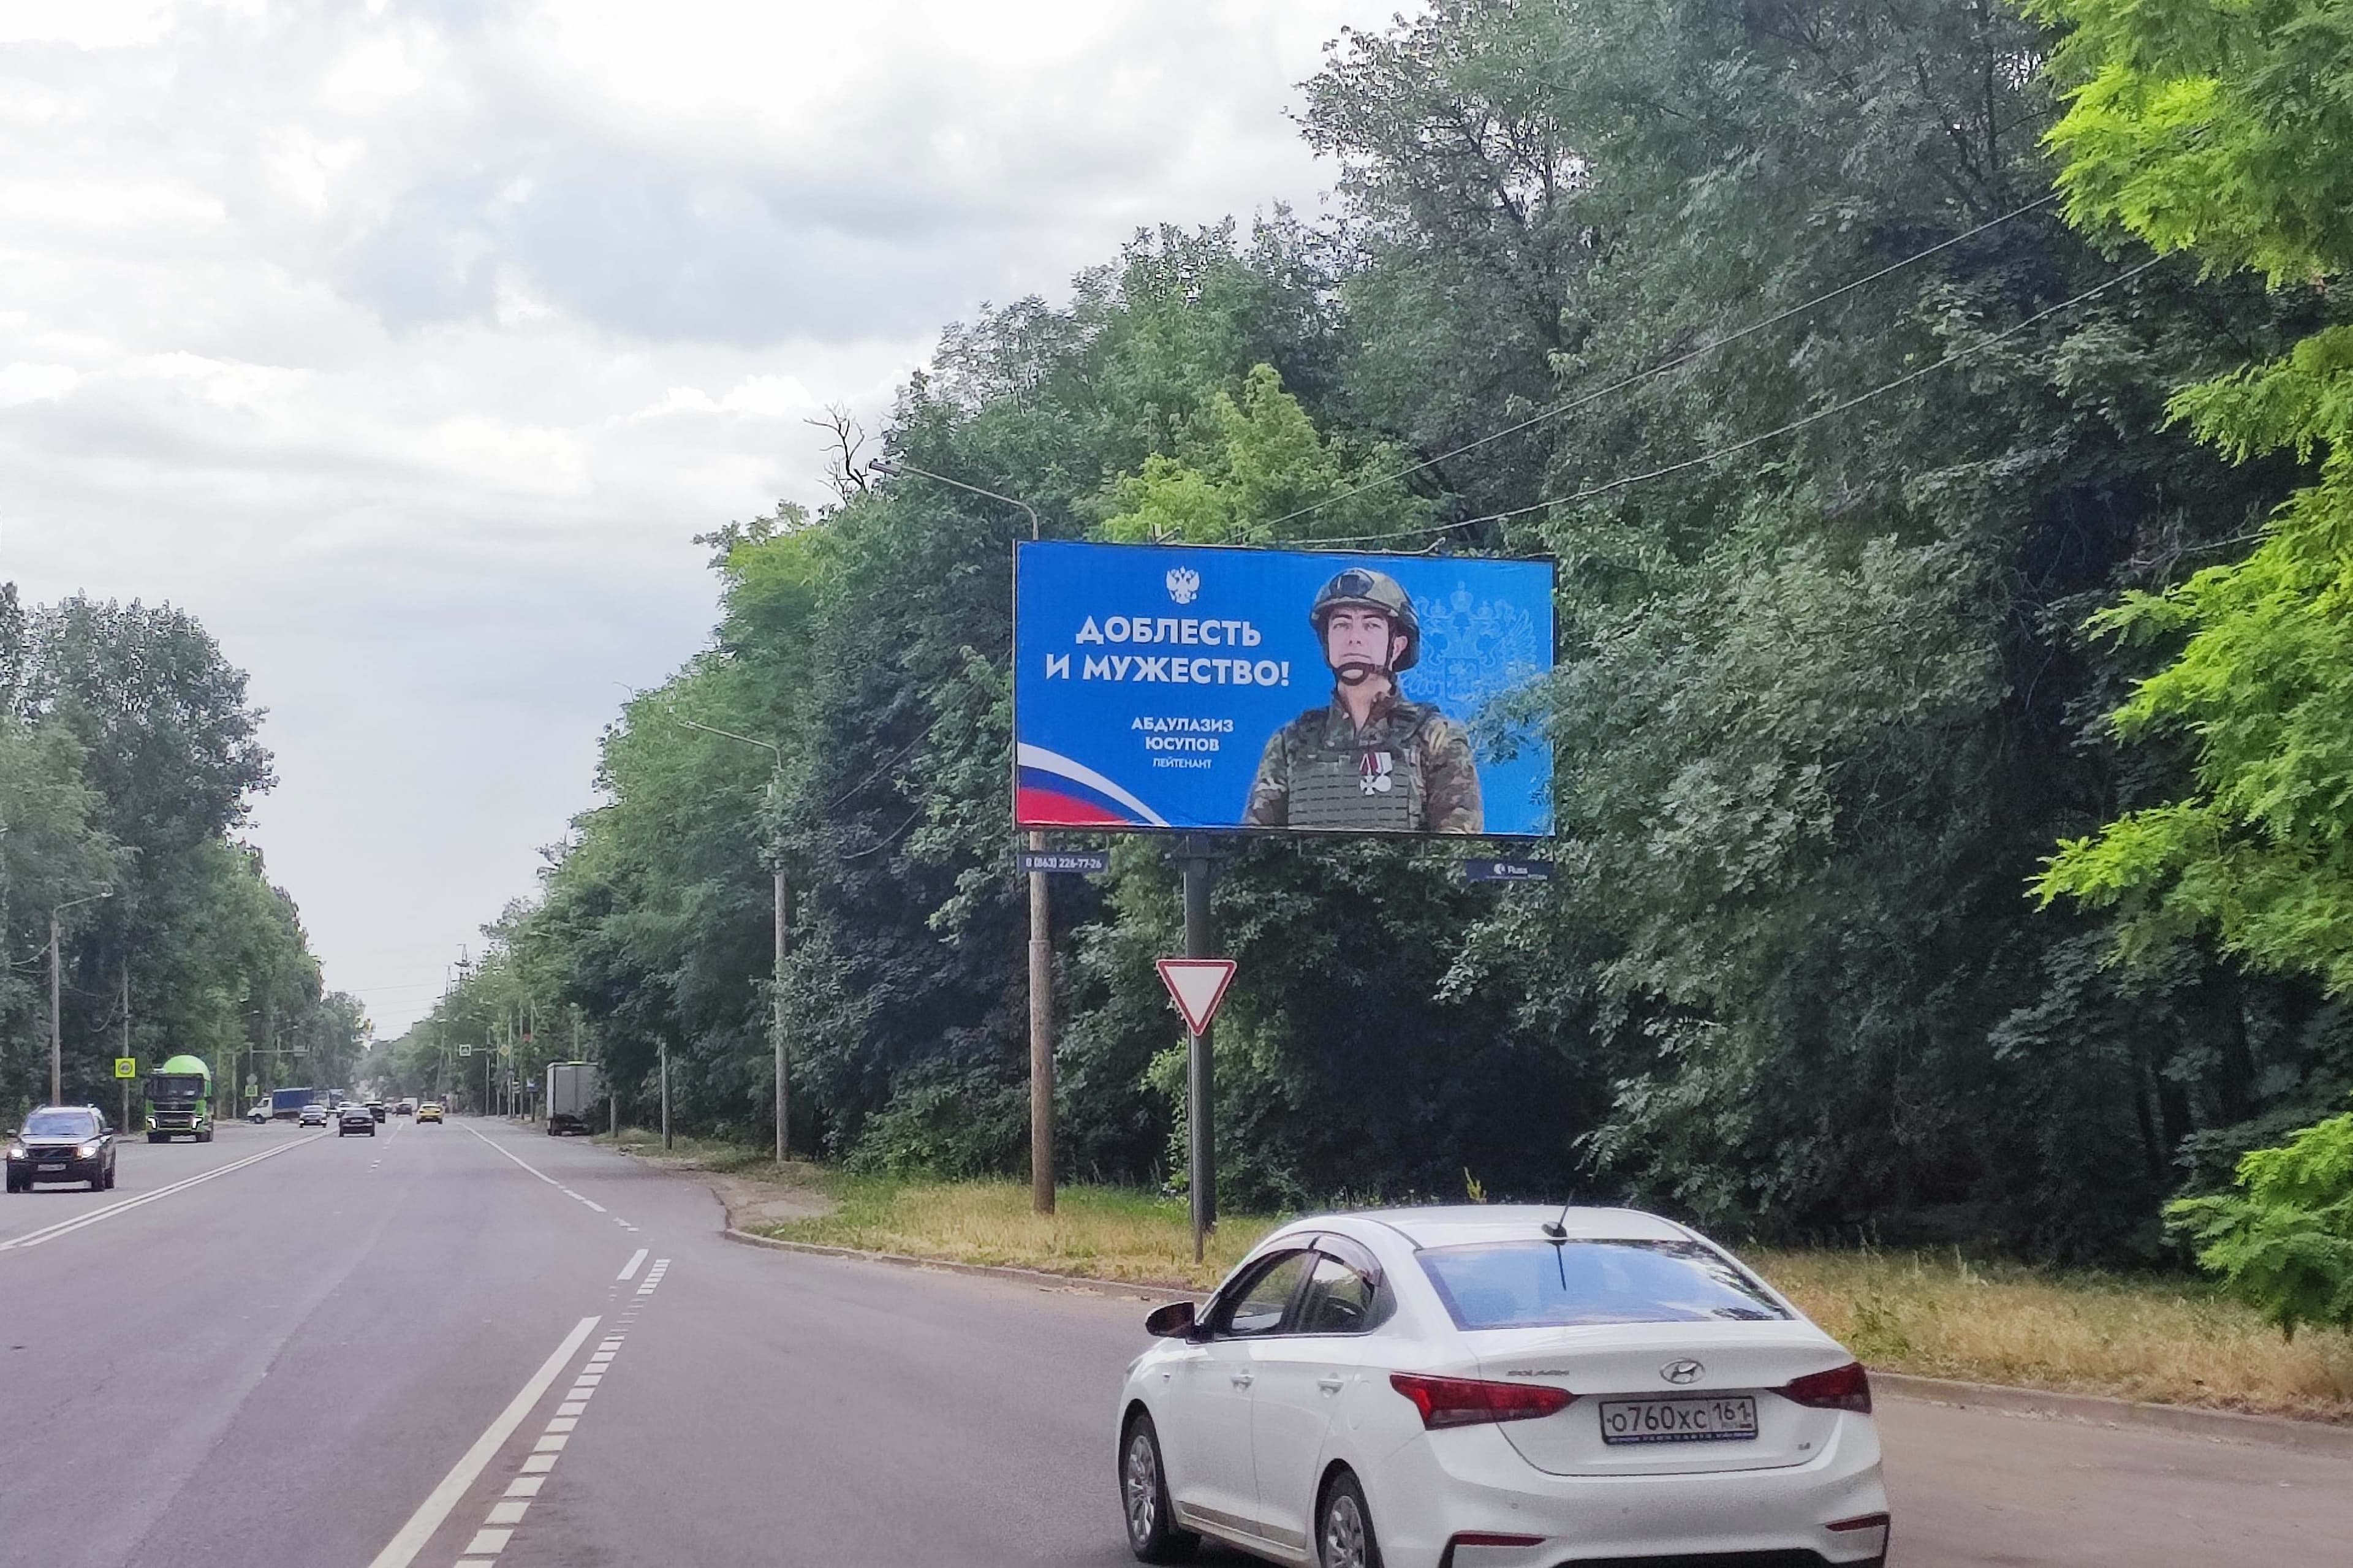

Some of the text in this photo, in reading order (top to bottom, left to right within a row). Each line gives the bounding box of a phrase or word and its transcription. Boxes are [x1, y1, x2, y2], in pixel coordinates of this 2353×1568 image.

[1075, 615, 1262, 646] ДОБЛЕСТЬ
[1045, 654, 1290, 686] И МУЖЕСТВО!
[1131, 717, 1233, 732] АБДУЛАЗИЗ
[1145, 737, 1219, 751] ЮСУПОВ
[1153, 756, 1212, 769] ЛЕЙТЕНАНТ
[1712, 1401, 1747, 1421] 161
